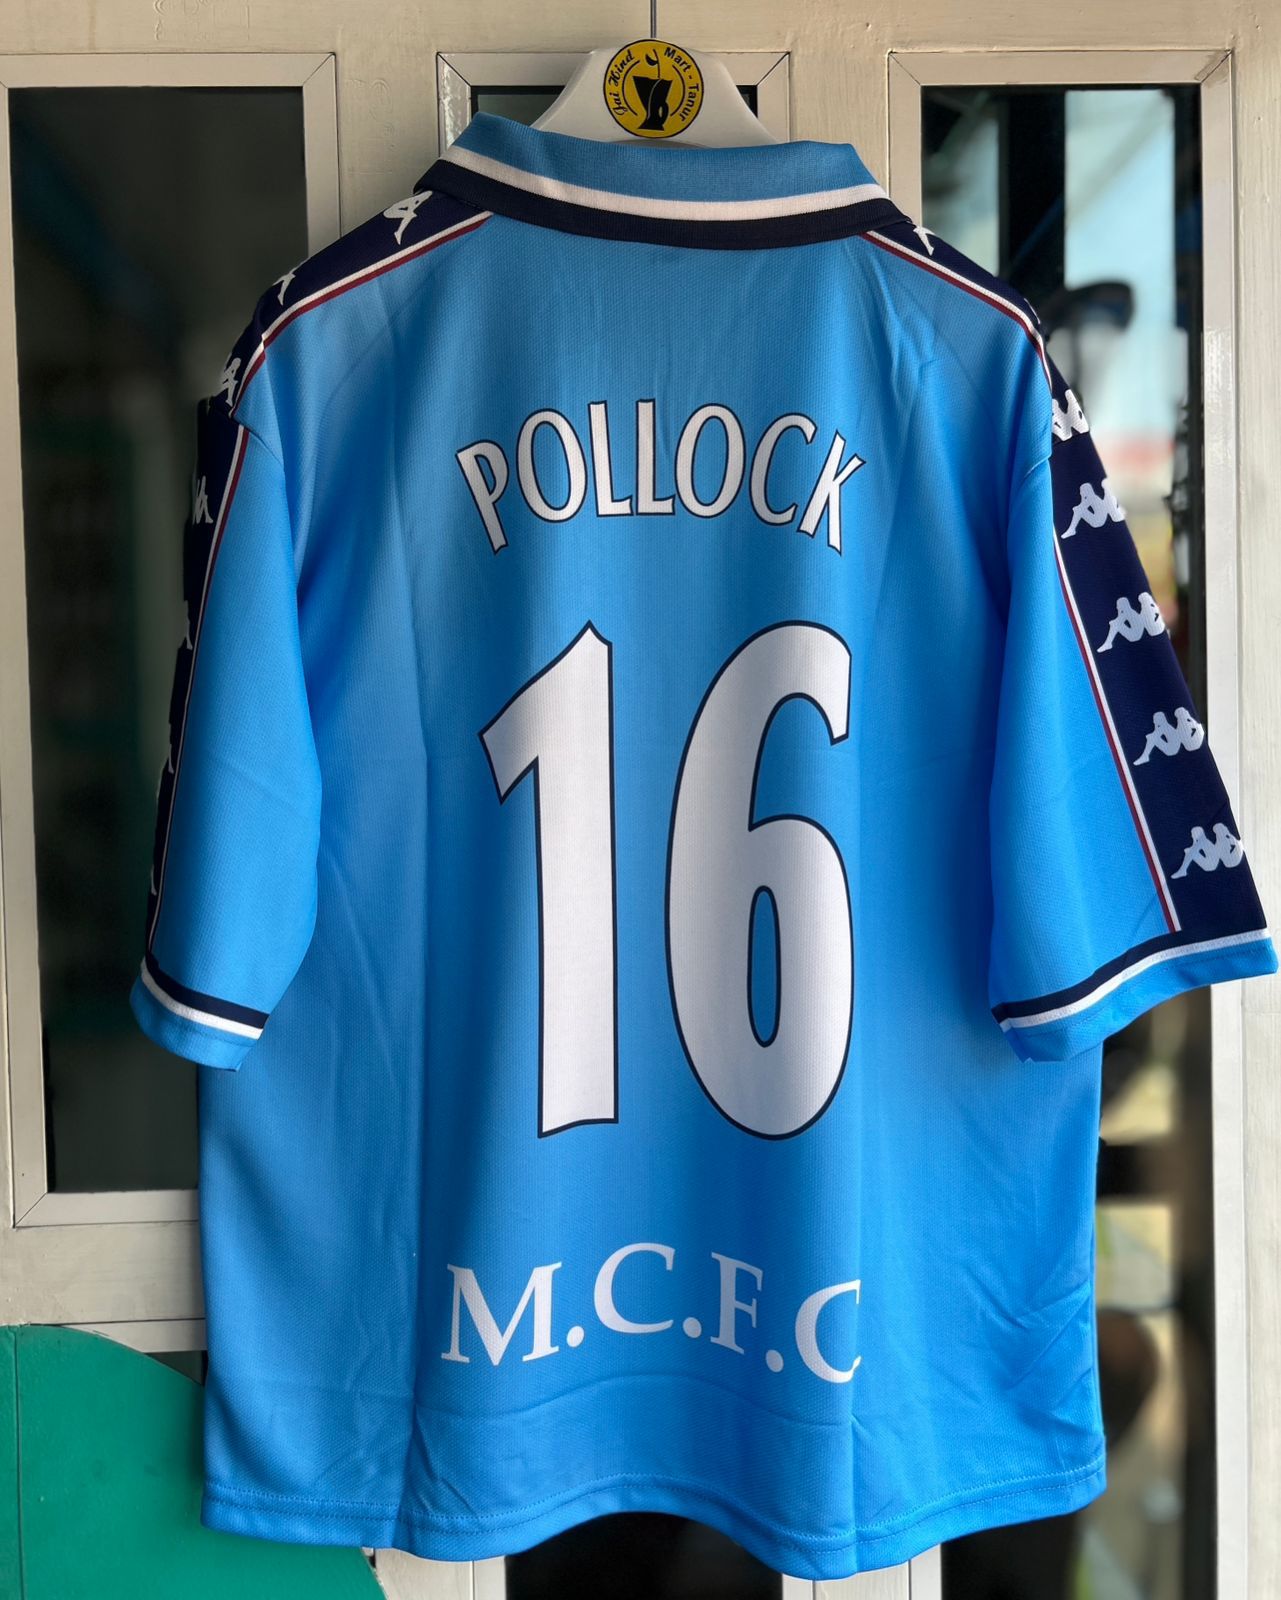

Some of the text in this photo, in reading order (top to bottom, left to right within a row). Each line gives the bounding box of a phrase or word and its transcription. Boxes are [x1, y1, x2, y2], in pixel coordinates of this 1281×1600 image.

[608, 49, 635, 87] Hind
[664, 47, 692, 72] Mart
[679, 83, 699, 122] Tanur
[455, 398, 866, 556] POLLOCK
[478, 619, 854, 1141] 16
[441, 1242, 862, 1384] M.C.F.C
